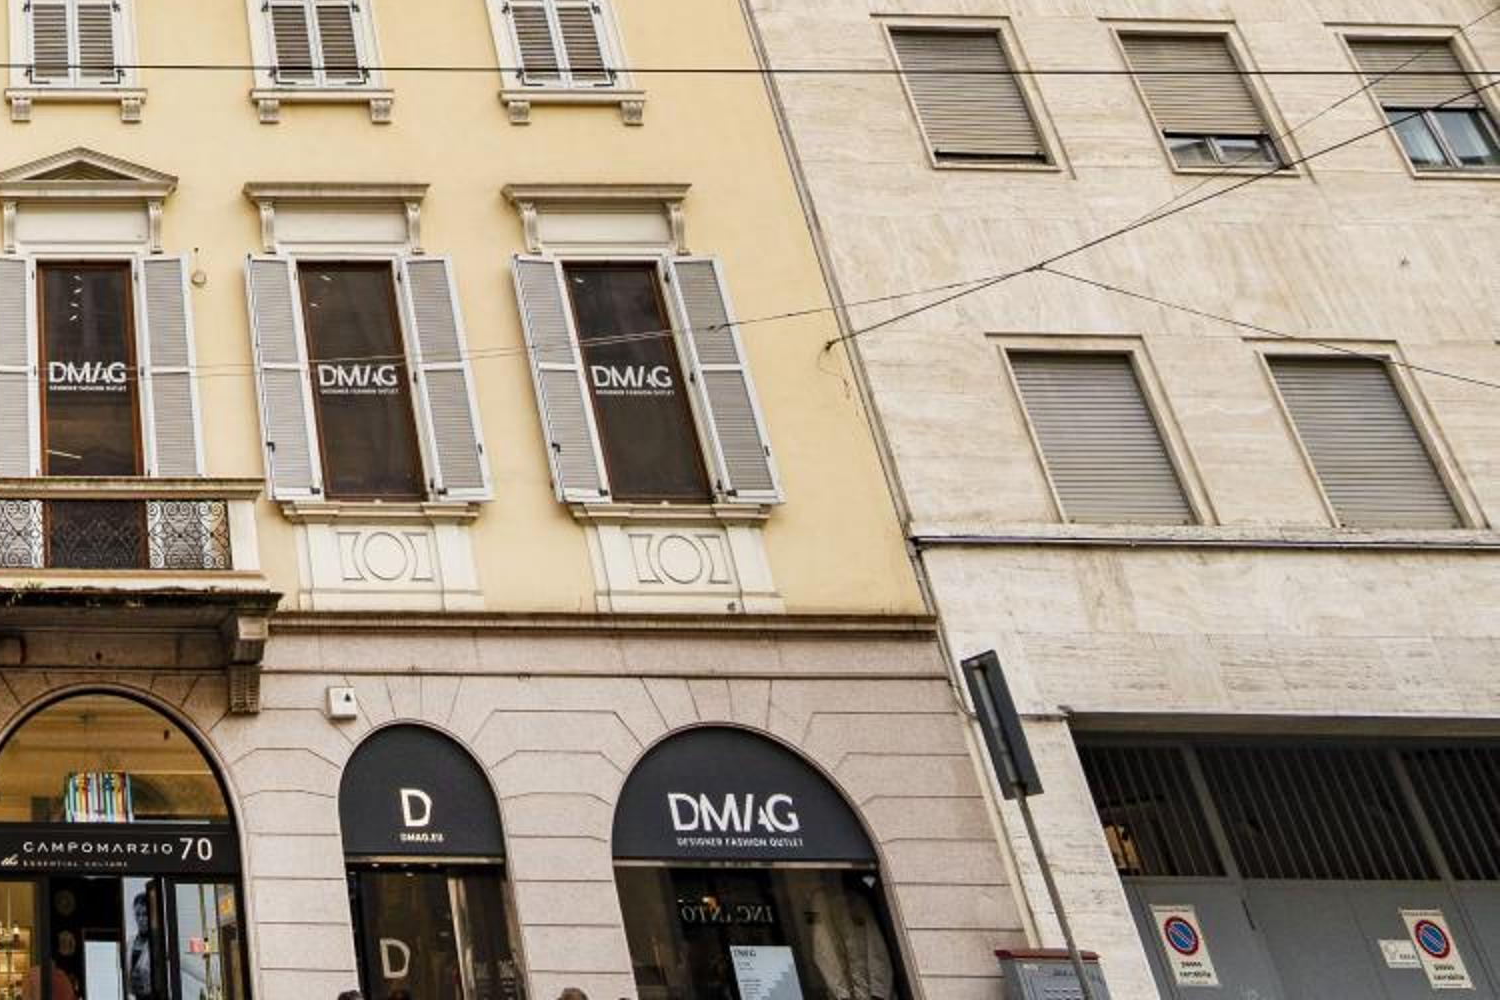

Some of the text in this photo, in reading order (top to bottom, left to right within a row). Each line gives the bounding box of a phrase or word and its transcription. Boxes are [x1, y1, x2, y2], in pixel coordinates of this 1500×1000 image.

[49, 361, 127, 383] DMAG
[317, 364, 398, 387] DMAG
[590, 365, 673, 388] DMAG
[400, 788, 433, 827] D
[667, 792, 800, 833] DMAG
[22, 837, 213, 861] CAMPOMARZIO 70
[676, 836, 722, 847] DESIGNER
[724, 837, 767, 847] FASHION
[379, 938, 411, 979] D
